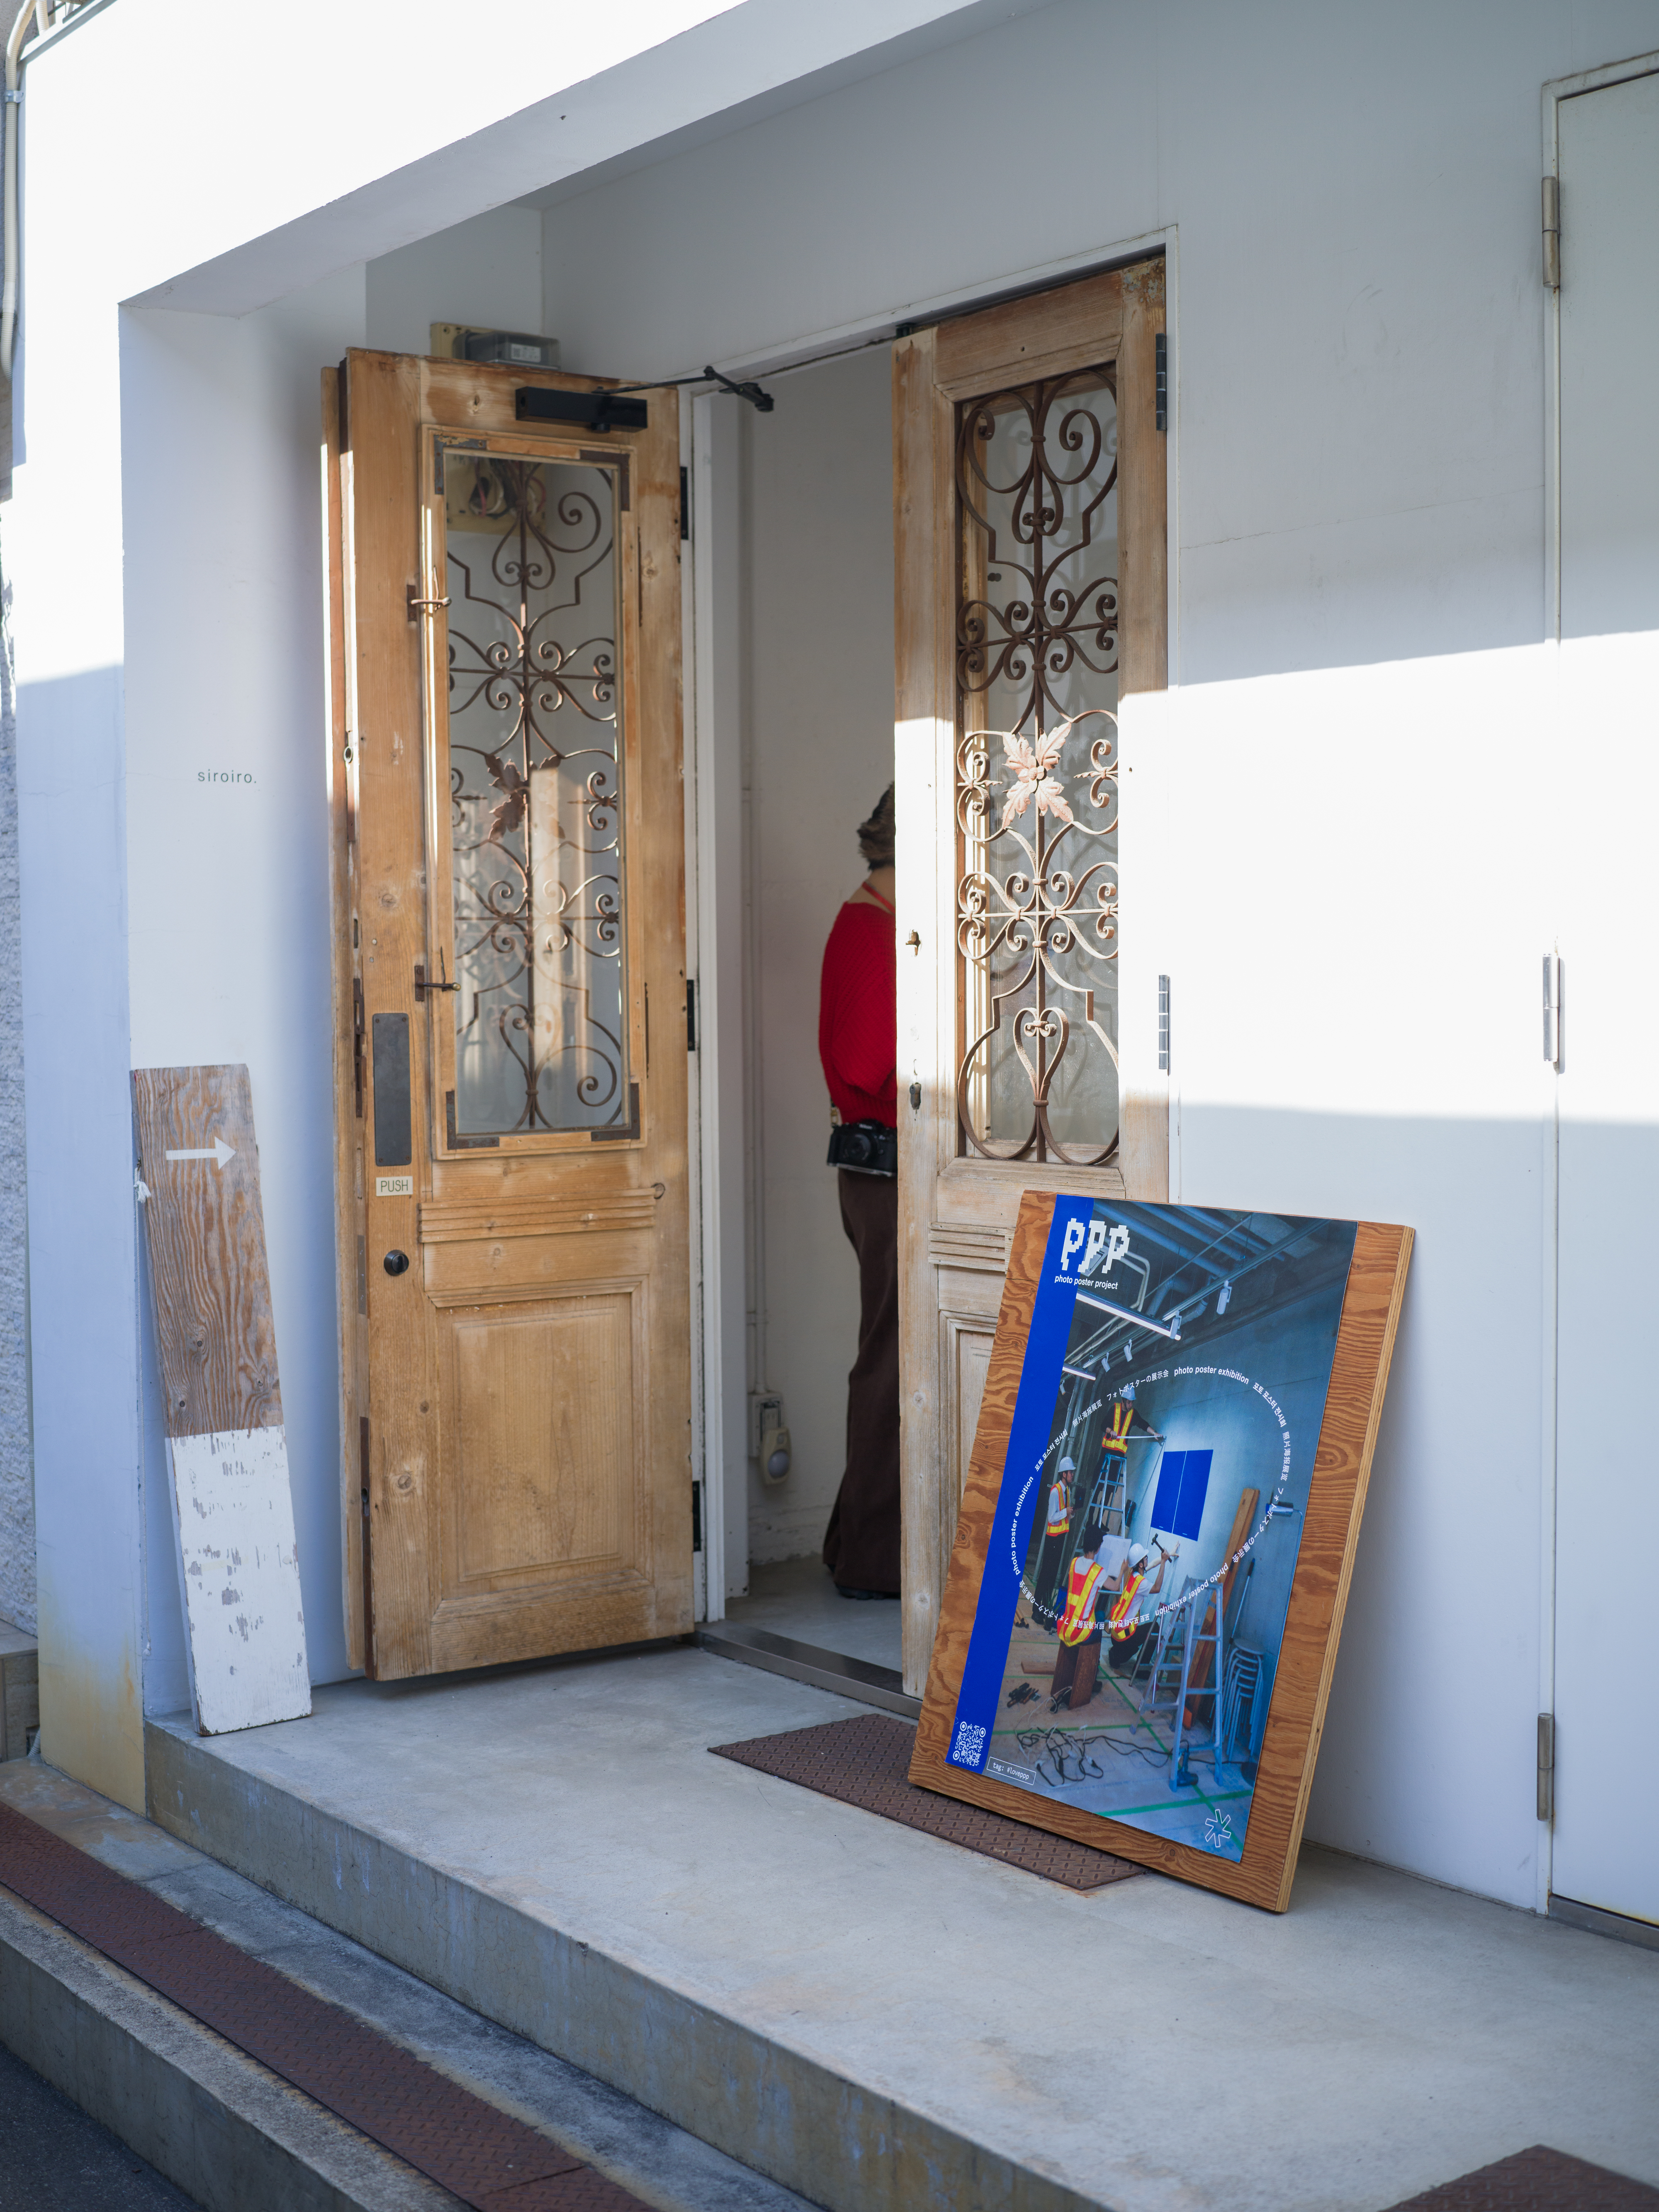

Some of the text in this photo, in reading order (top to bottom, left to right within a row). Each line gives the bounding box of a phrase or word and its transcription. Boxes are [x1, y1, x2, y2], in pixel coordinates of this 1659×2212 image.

[198, 769, 256, 783] siroiro.
[381, 1180, 408, 1192] PUSH
[1055, 1275, 1073, 1284] photo
[1095, 1280, 1118, 1290] project
[1107, 1370, 1169, 1401] フォトポスターの展示会
[1174, 1366, 1249, 1384] photo poster exhibition
[1072, 1399, 1102, 1428] 照片海报展览
[1253, 1382, 1287, 1428] 포토 포스터 전시회
[1035, 1429, 1068, 1472] 포토 포스터 전시회
[1280, 1431, 1291, 1482] 照片海报展览
[1015, 1476, 1034, 1516] exhibition
[1232, 1487, 1284, 1562] フォトポスターの展示会
[1011, 1550, 1021, 1575] photo
[1019, 1579, 1069, 1625] フォトポスターの展示会
[1155, 1562, 1229, 1616] photo poster exhibition
[992, 1762, 1029, 1780] tag: #loveppp
